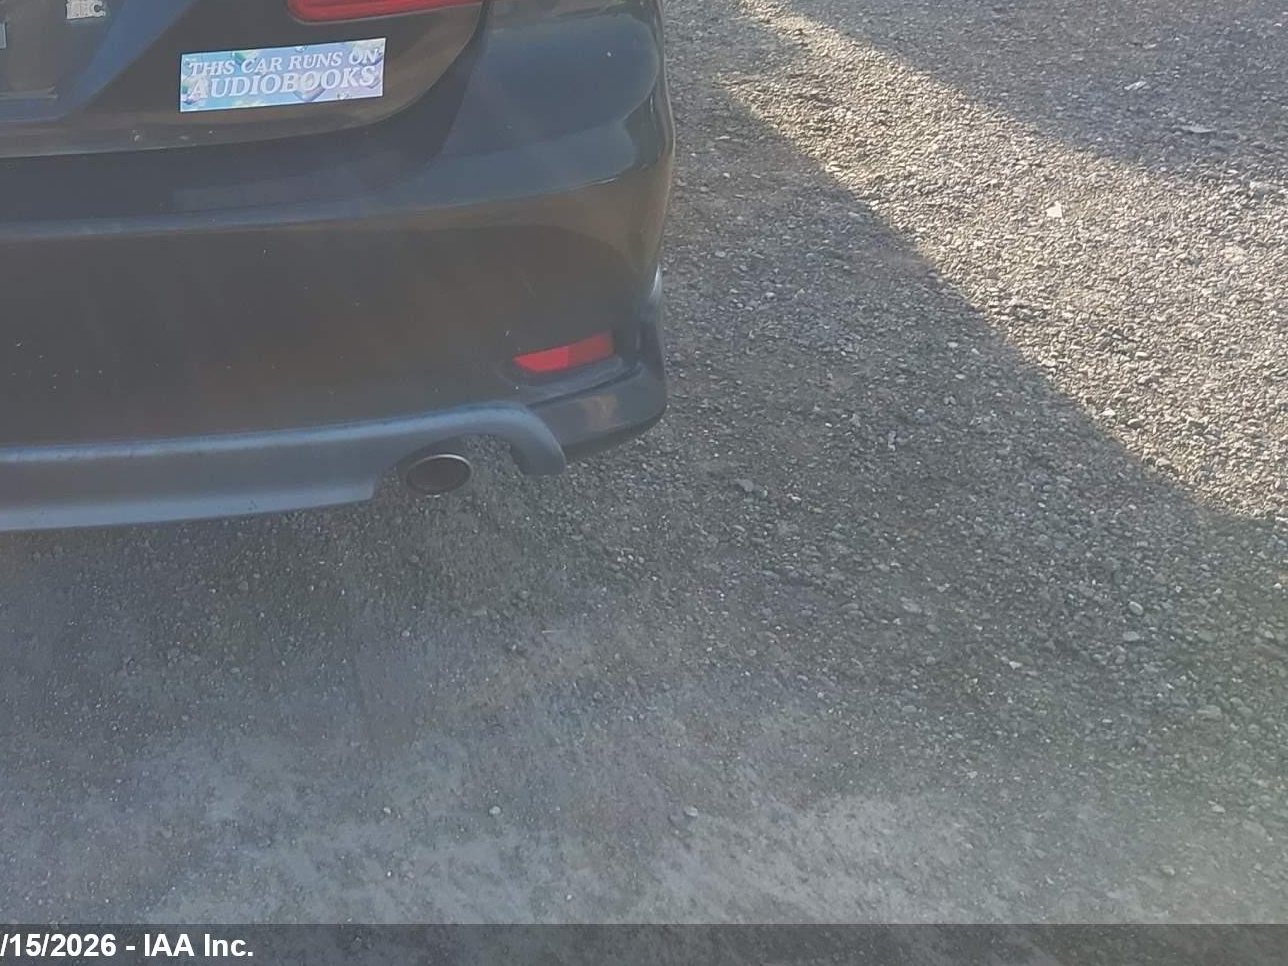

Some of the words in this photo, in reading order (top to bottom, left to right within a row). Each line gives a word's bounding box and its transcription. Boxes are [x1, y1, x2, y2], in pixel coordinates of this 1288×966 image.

[189, 60, 235, 77] THIS
[241, 56, 282, 73] CAR
[287, 52, 343, 70] RUNS
[349, 49, 378, 66] ON
[189, 66, 376, 99] AUDIOBOOKS
